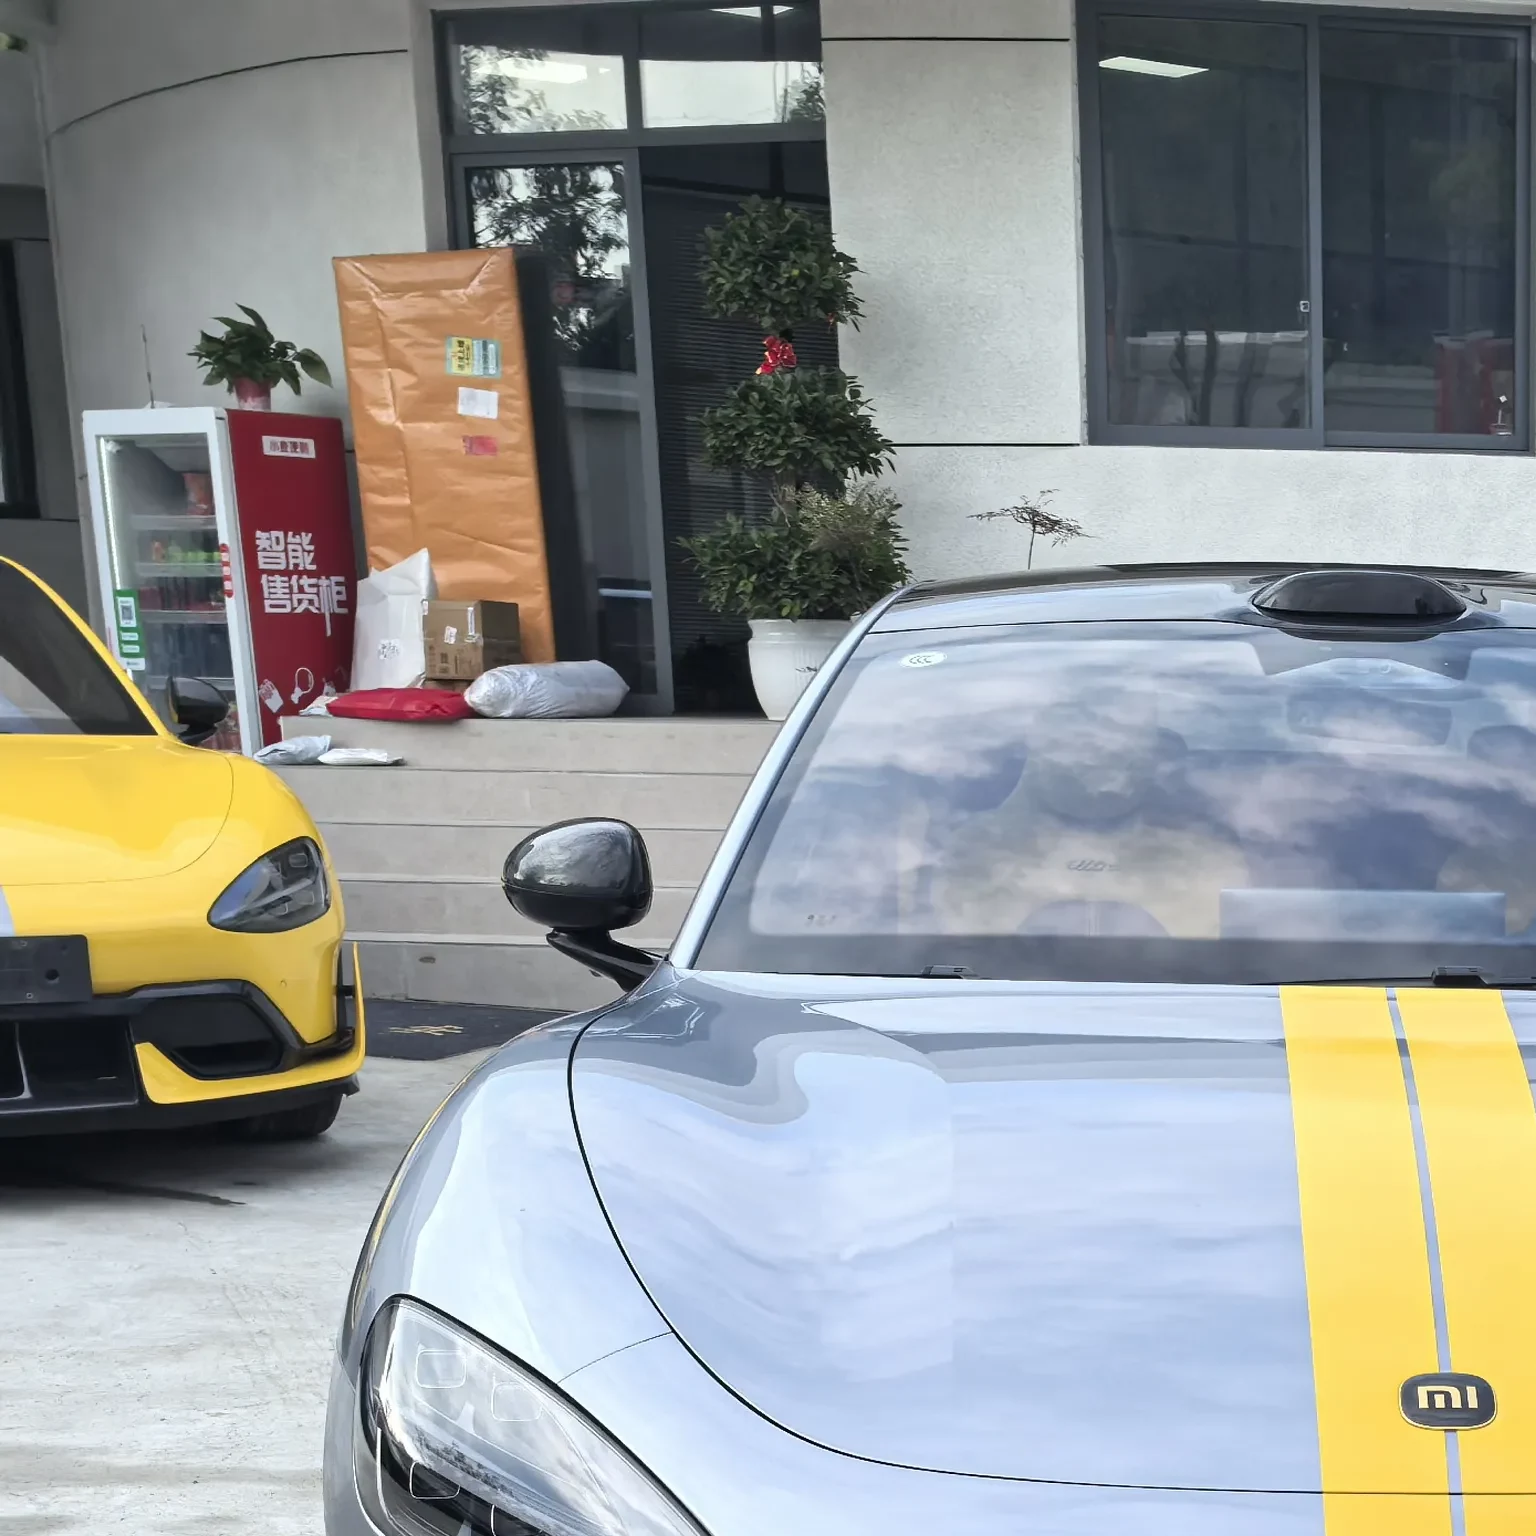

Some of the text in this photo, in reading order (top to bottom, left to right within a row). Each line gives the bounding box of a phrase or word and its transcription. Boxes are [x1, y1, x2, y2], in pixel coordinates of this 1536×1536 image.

[255, 530, 317, 571] 智能
[260, 574, 348, 637] 售货柜
